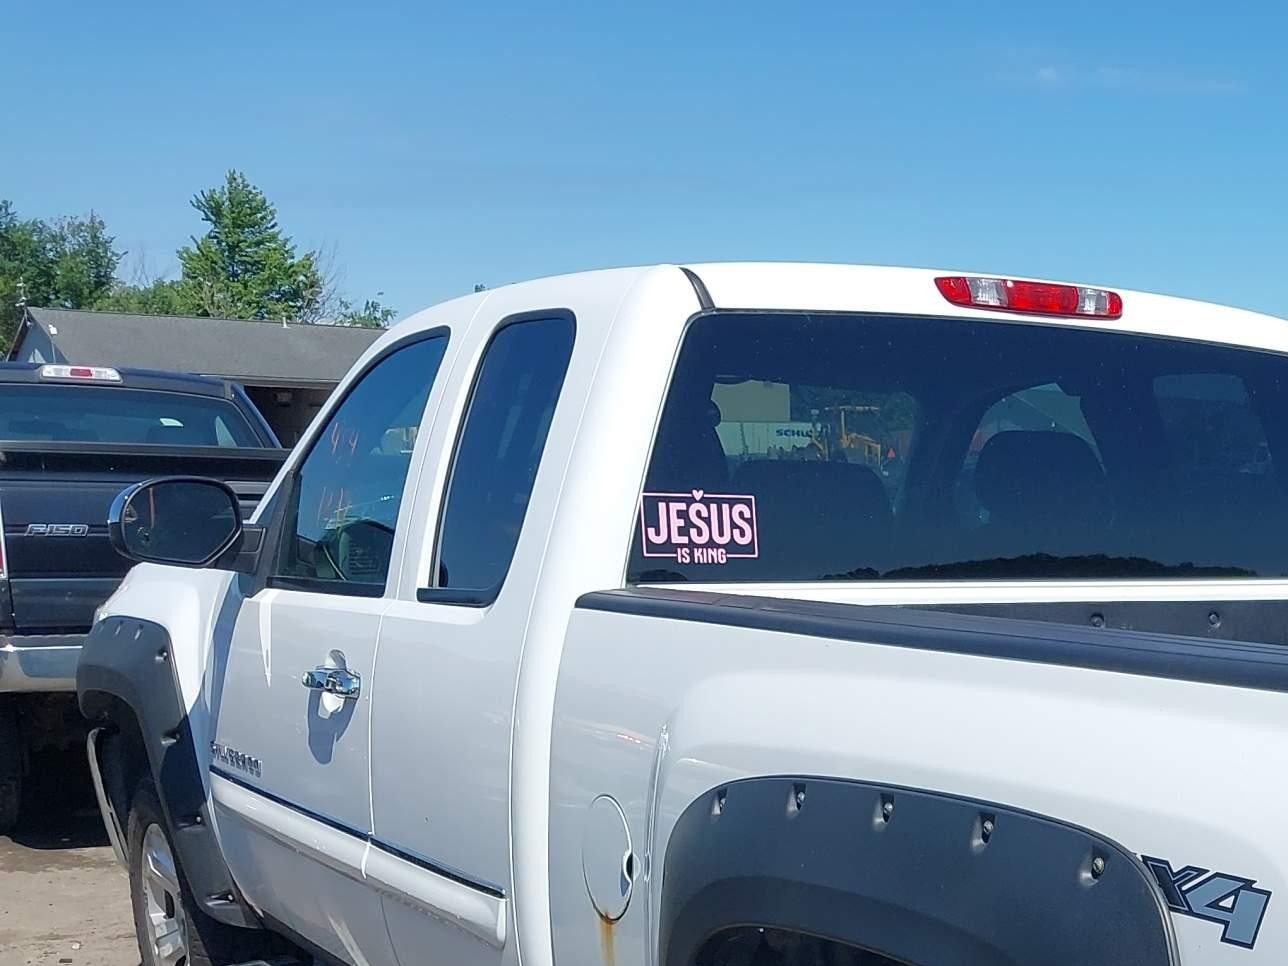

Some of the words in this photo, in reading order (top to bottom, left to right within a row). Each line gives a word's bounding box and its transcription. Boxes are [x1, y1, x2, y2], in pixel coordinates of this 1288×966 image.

[647, 502, 753, 545] JESUS
[677, 547, 691, 564] IS
[693, 547, 728, 564] KING
